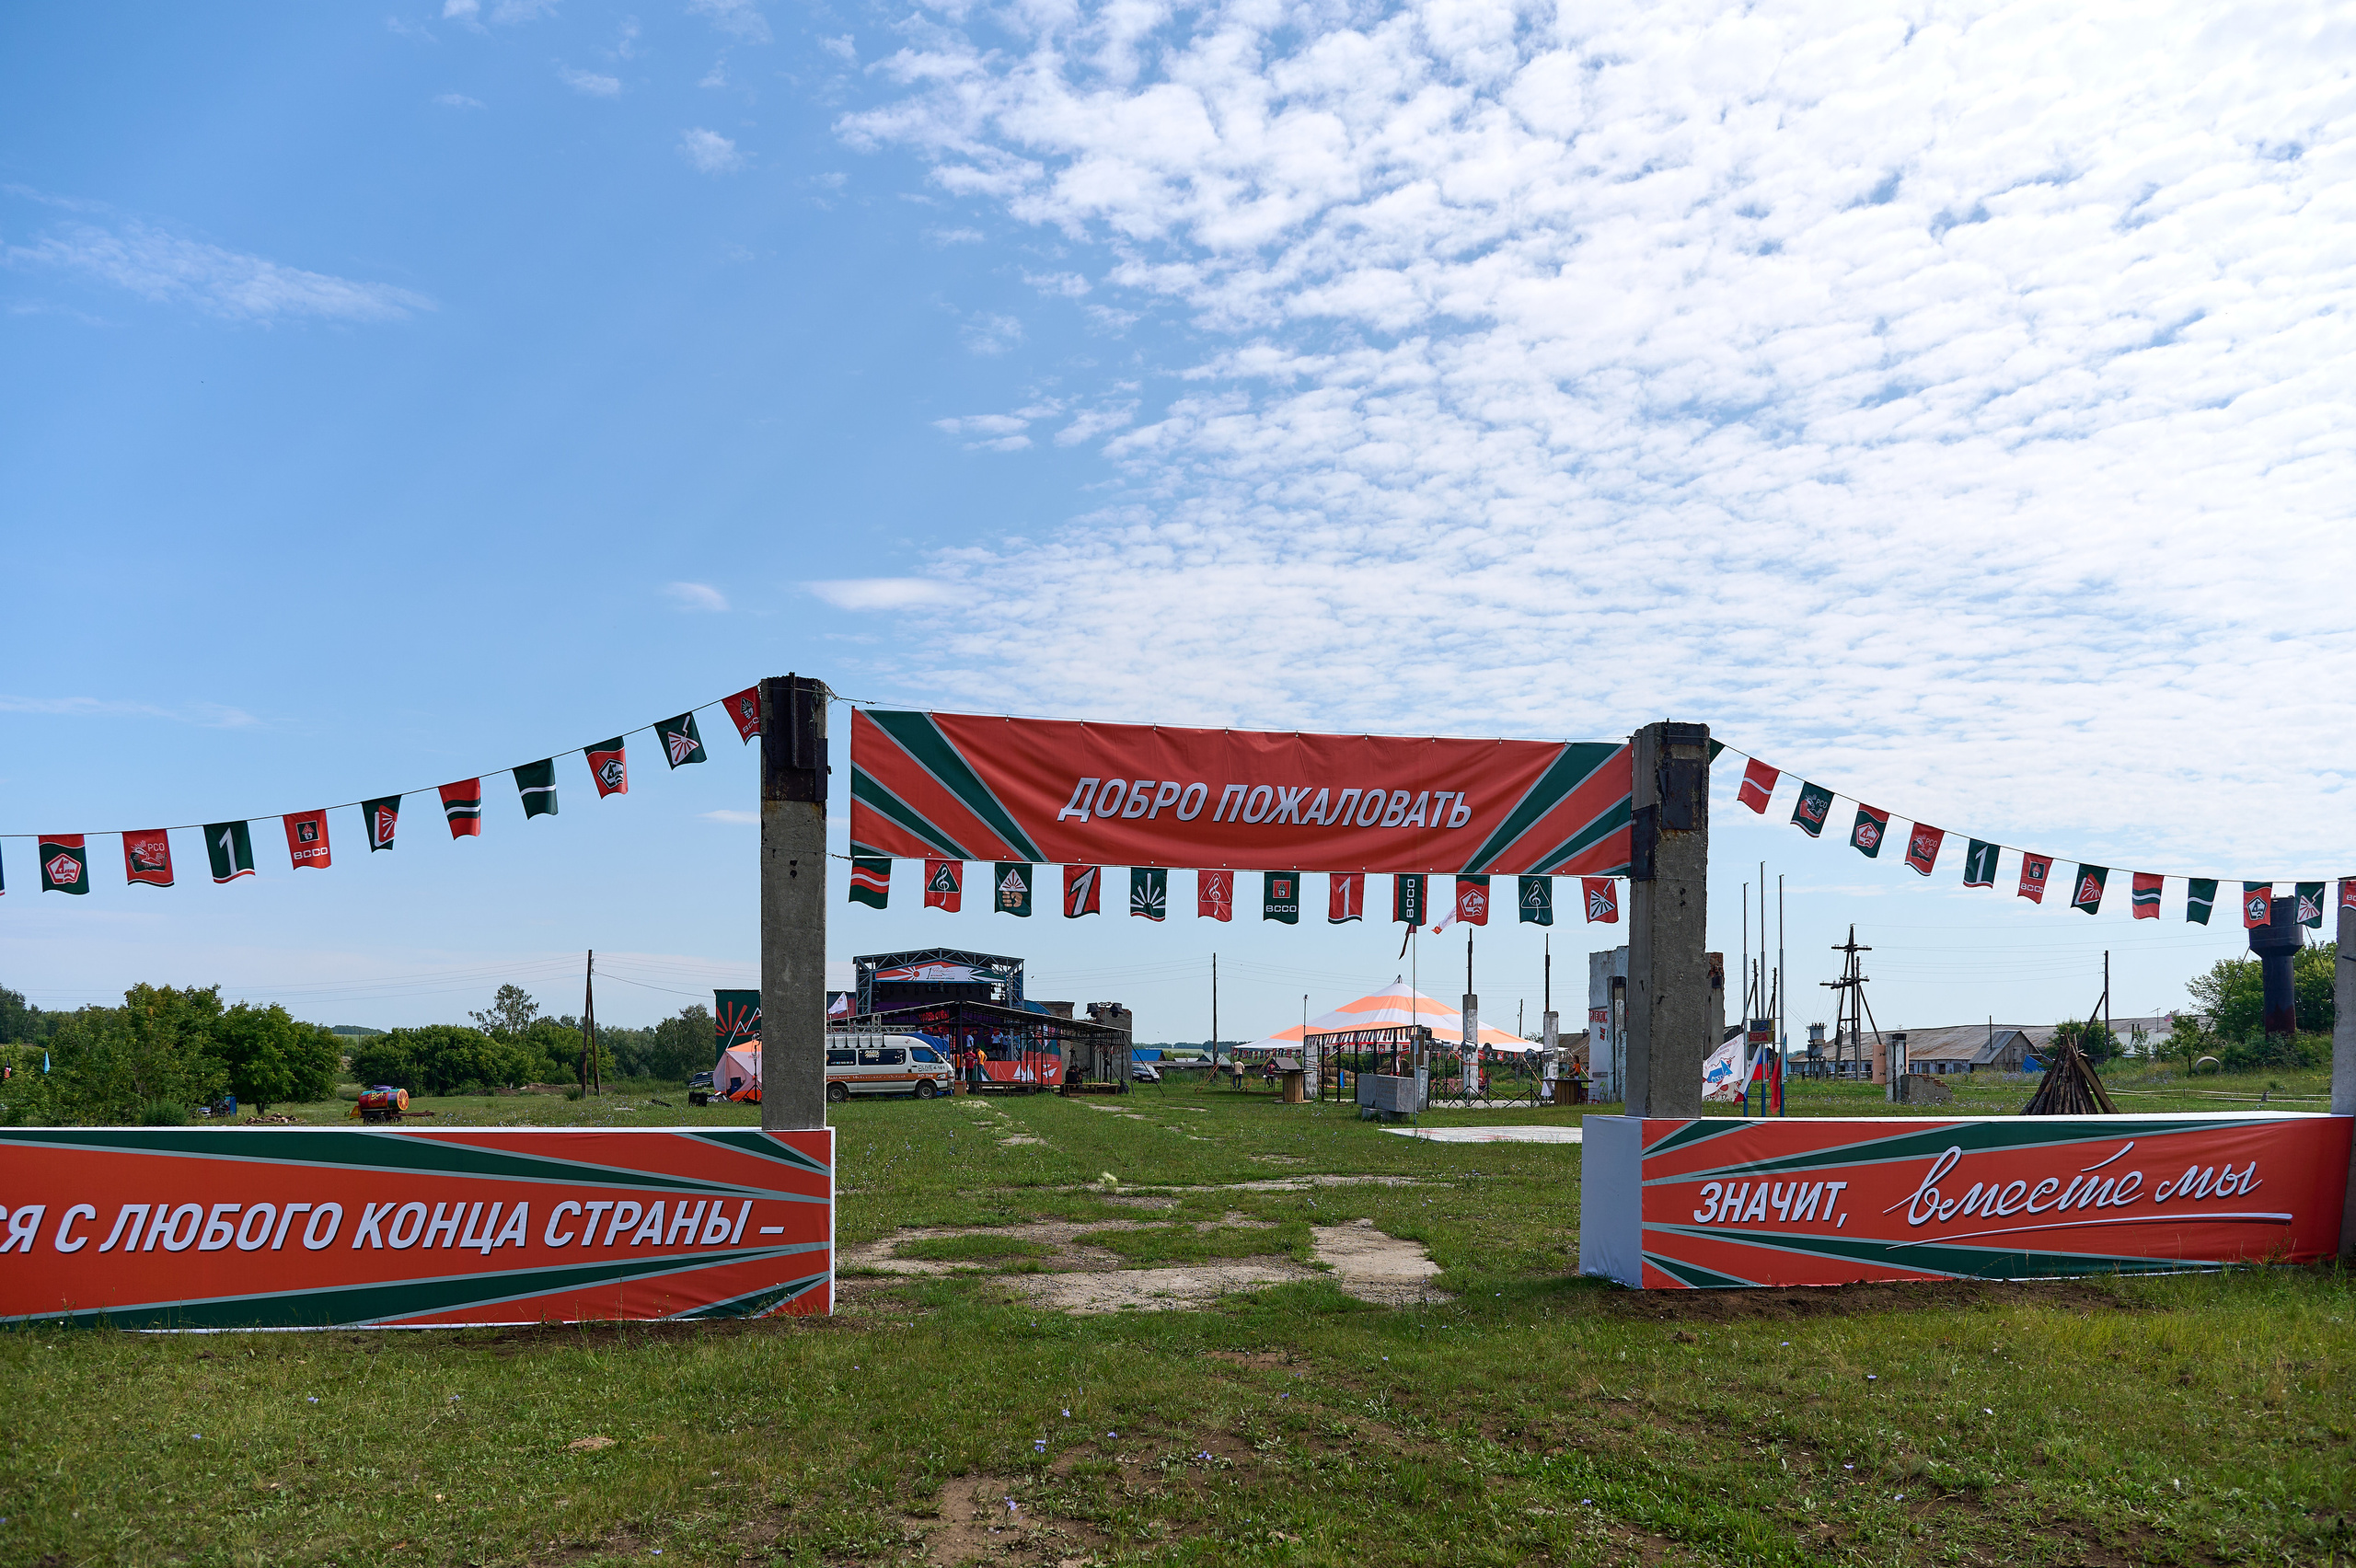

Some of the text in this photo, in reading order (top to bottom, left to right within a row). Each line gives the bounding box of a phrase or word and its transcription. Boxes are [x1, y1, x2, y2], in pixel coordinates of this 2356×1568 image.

[1057, 777, 1472, 829] ДОБРО ПОЖАЛОВАТЬ
[147, 843, 165, 852] РСО
[218, 826, 237, 875] 1
[293, 847, 329, 860] ВССО
[1265, 905, 1297, 913] ВССО
[1339, 876, 1351, 918] 1
[1692, 1141, 2263, 1228] ЗНАЧИТ, вместе мы
[54, 1203, 97, 1252] С
[98, 1202, 343, 1252] ЛЮБОГО
[352, 1201, 529, 1255] КОНЦА
[543, 1200, 753, 1247] СТРАНЫ
